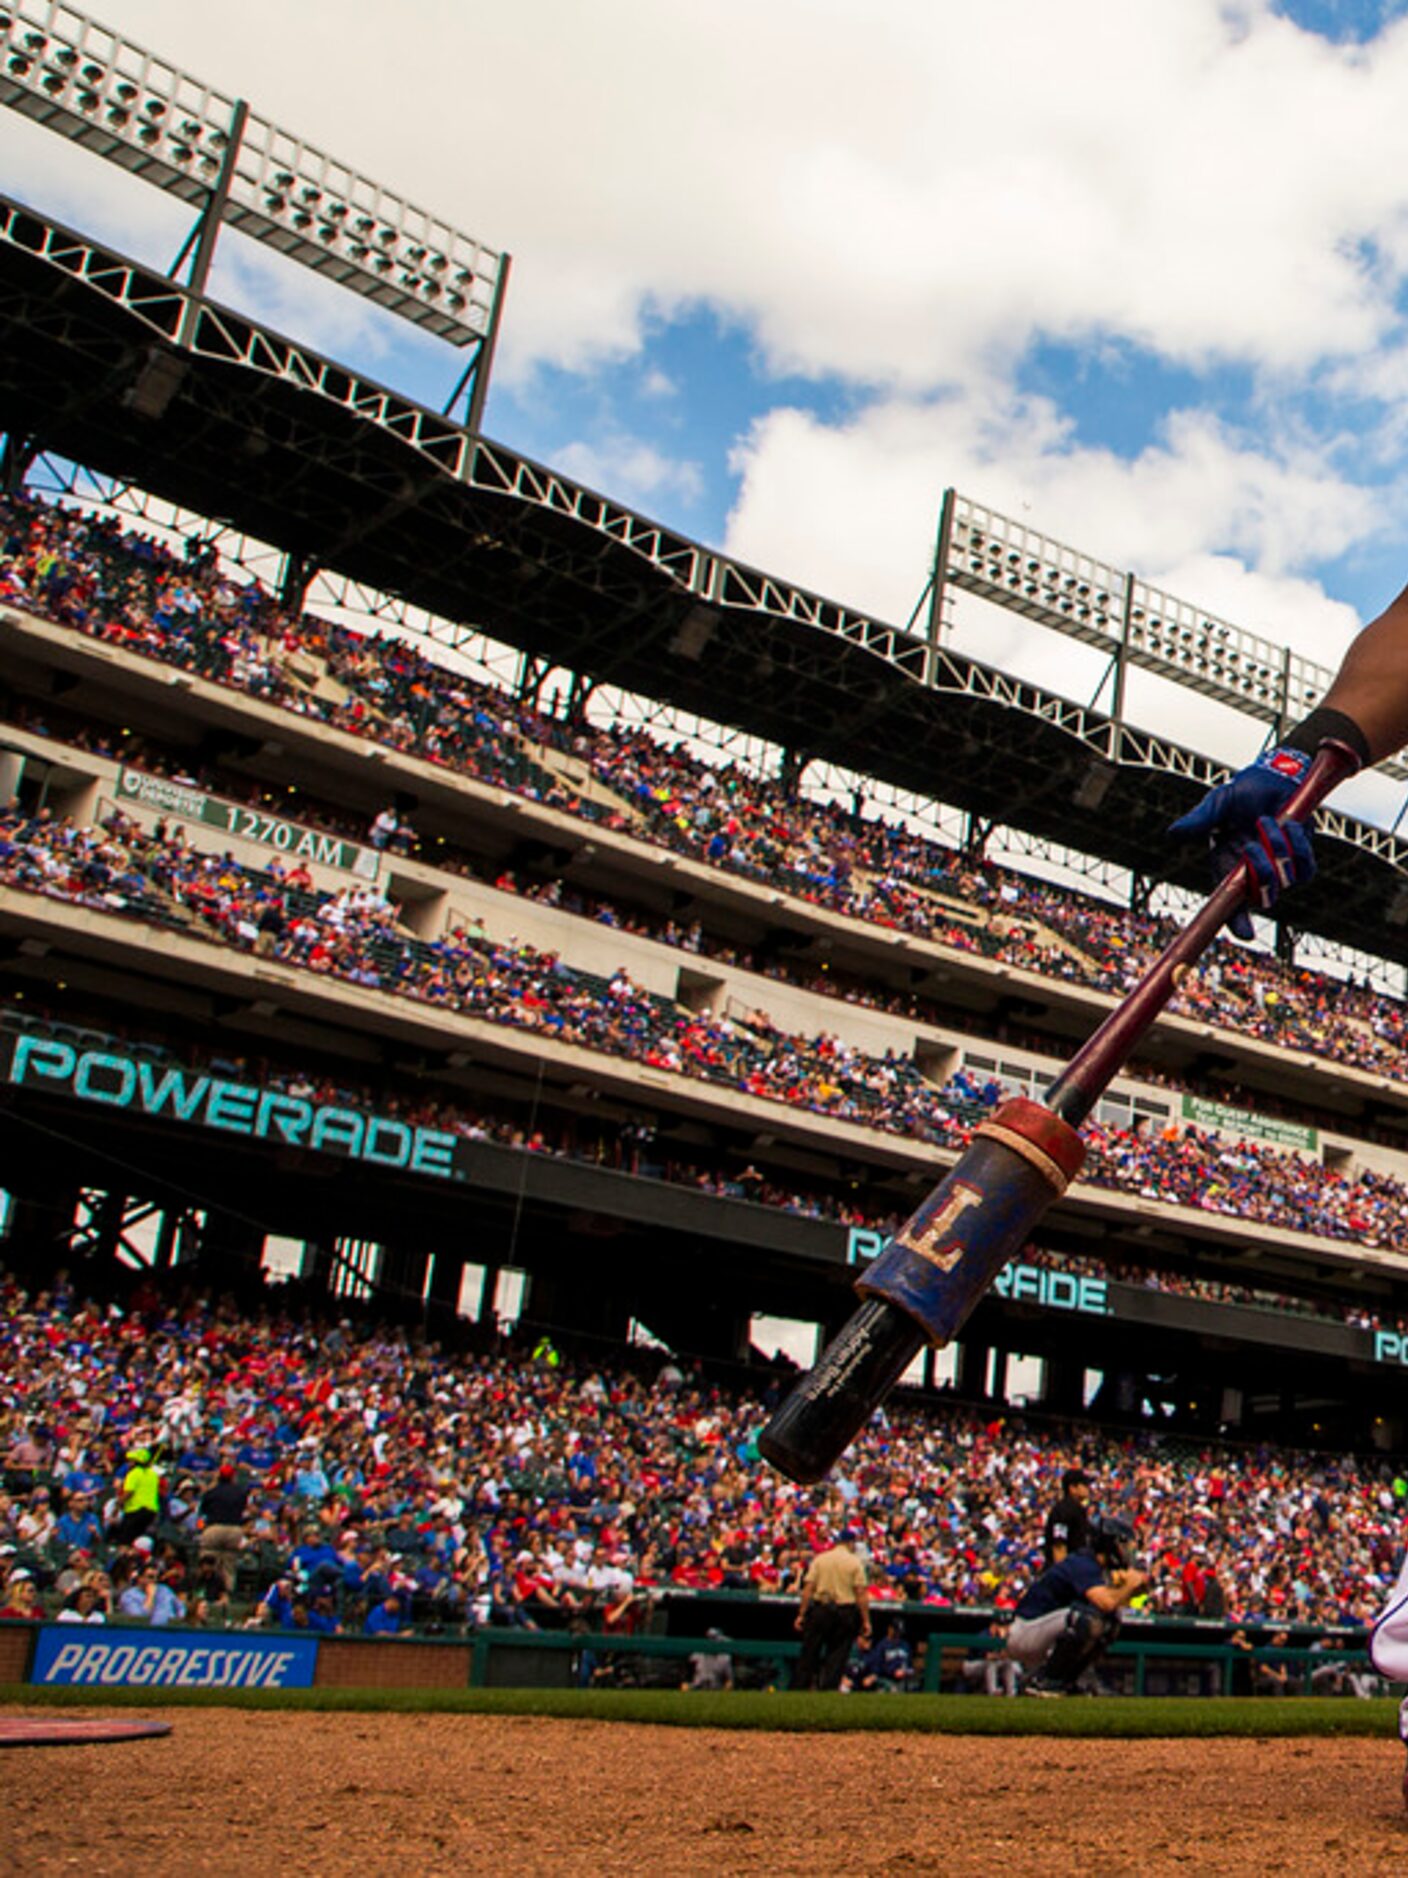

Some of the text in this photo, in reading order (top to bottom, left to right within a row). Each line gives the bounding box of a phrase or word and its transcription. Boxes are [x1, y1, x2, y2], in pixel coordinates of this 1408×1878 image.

[227, 807, 343, 867] 1270 AM
[9, 1035, 458, 1178] POWERADE
[46, 1644, 295, 1687] PROGRESSIVE
